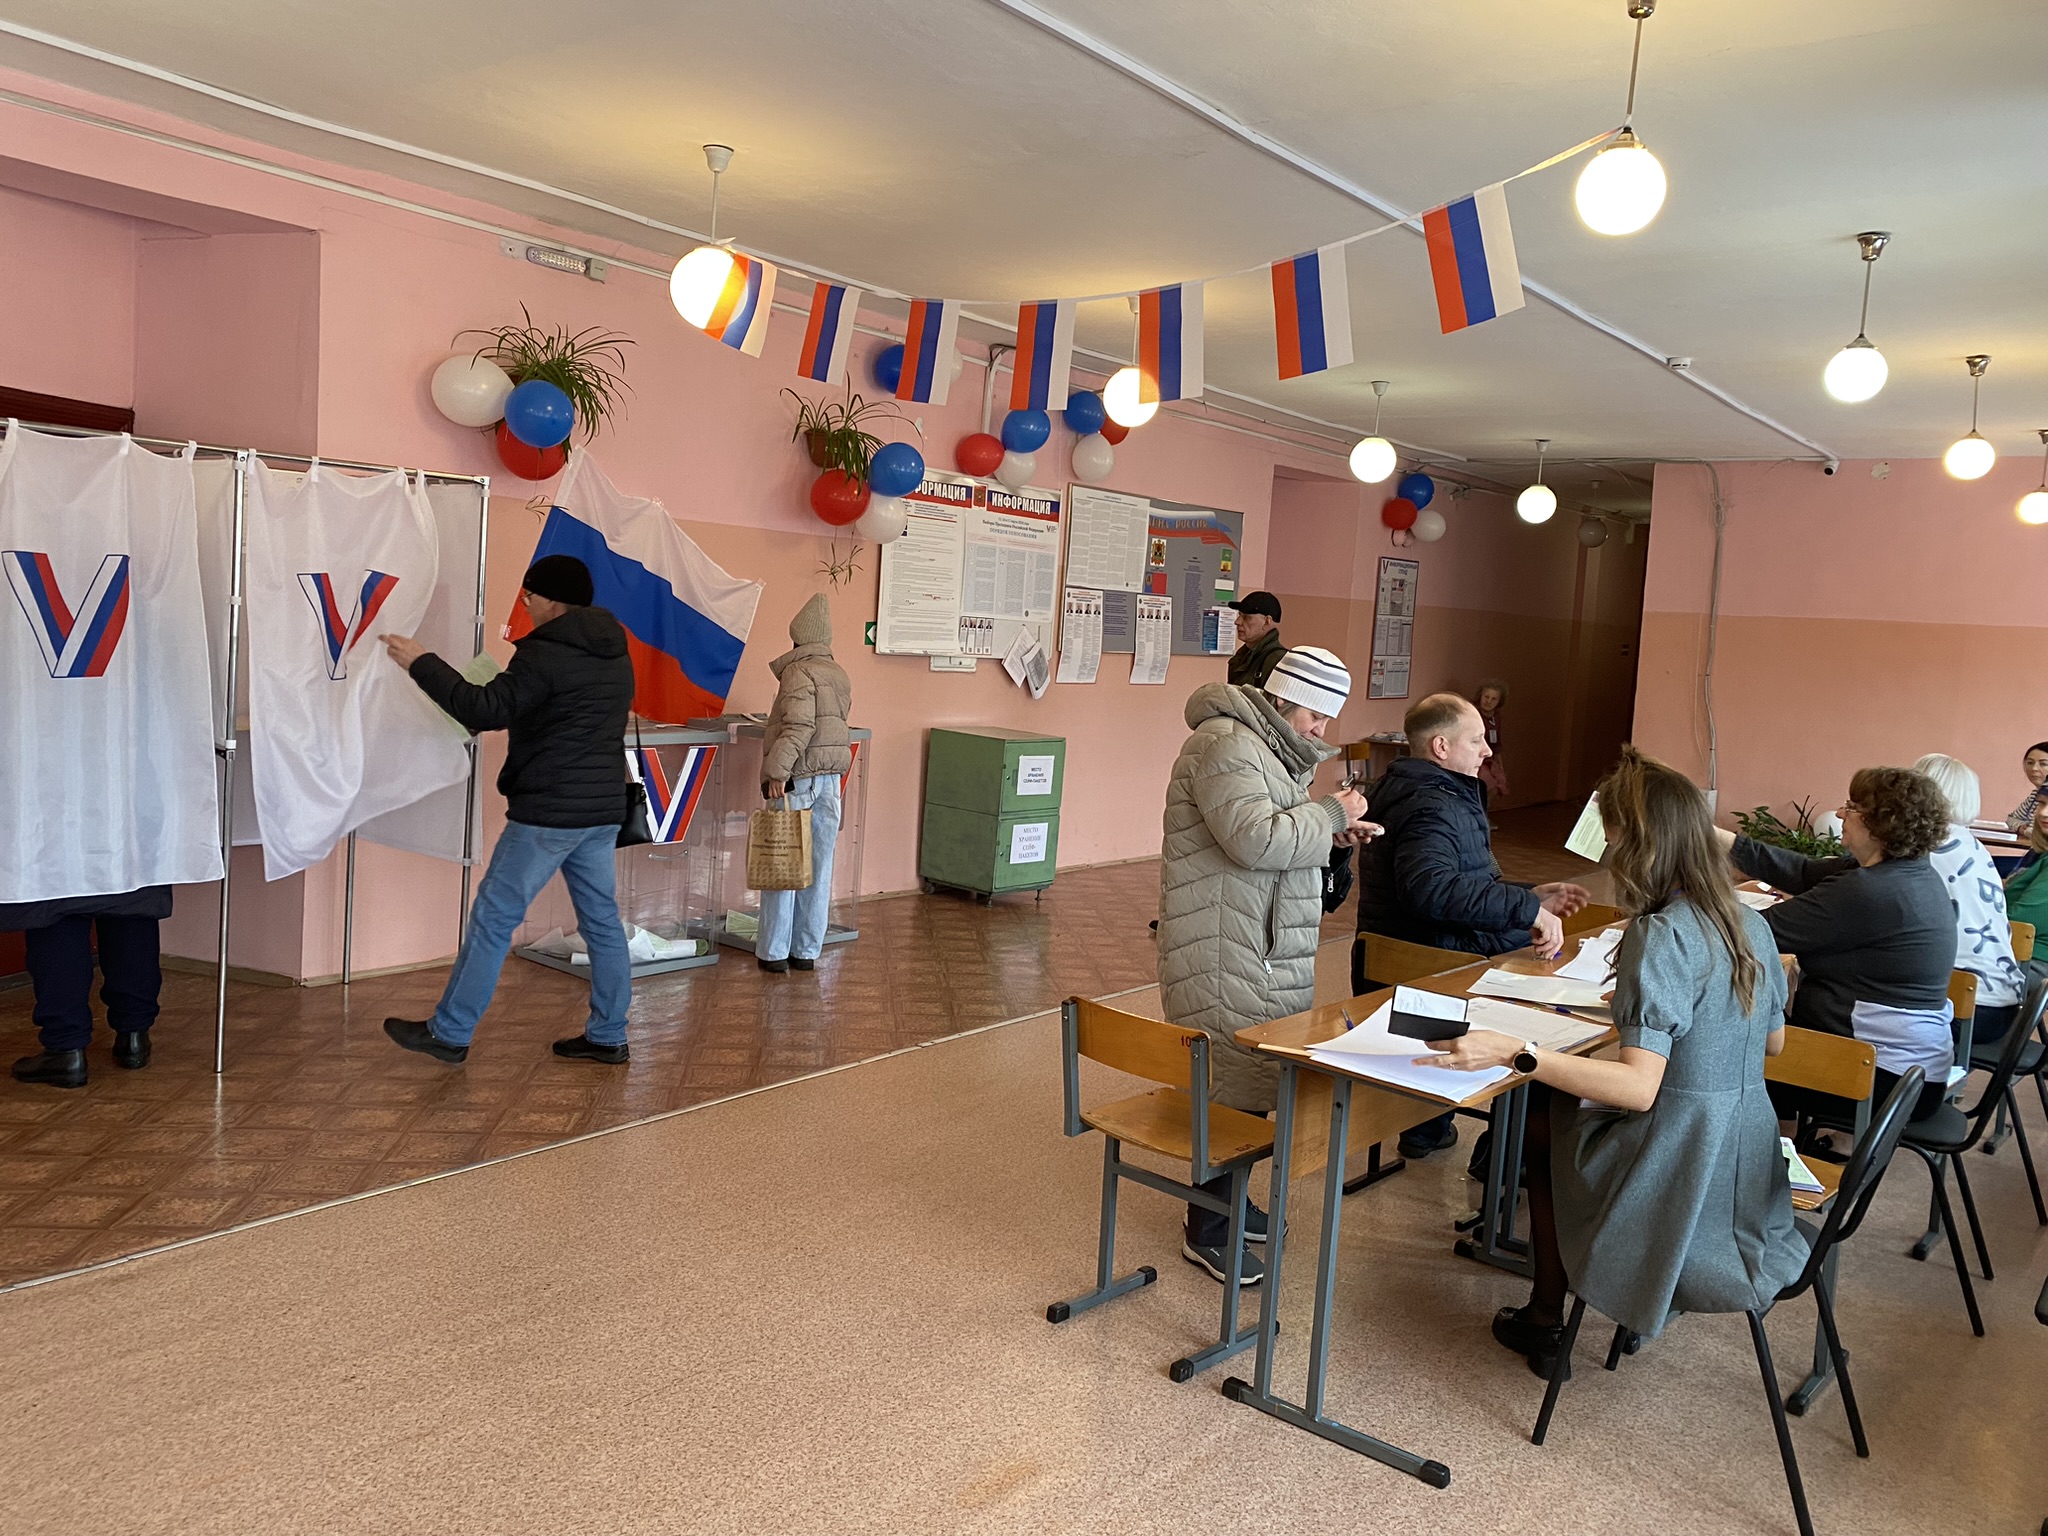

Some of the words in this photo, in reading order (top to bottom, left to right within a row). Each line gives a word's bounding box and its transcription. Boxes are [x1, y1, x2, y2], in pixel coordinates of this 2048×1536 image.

[914, 480, 967, 501] ФОРМАЦИЯ
[991, 491, 1052, 515] ИНФОРМАЦИЯ
[1181, 1035, 1191, 1048] 10
